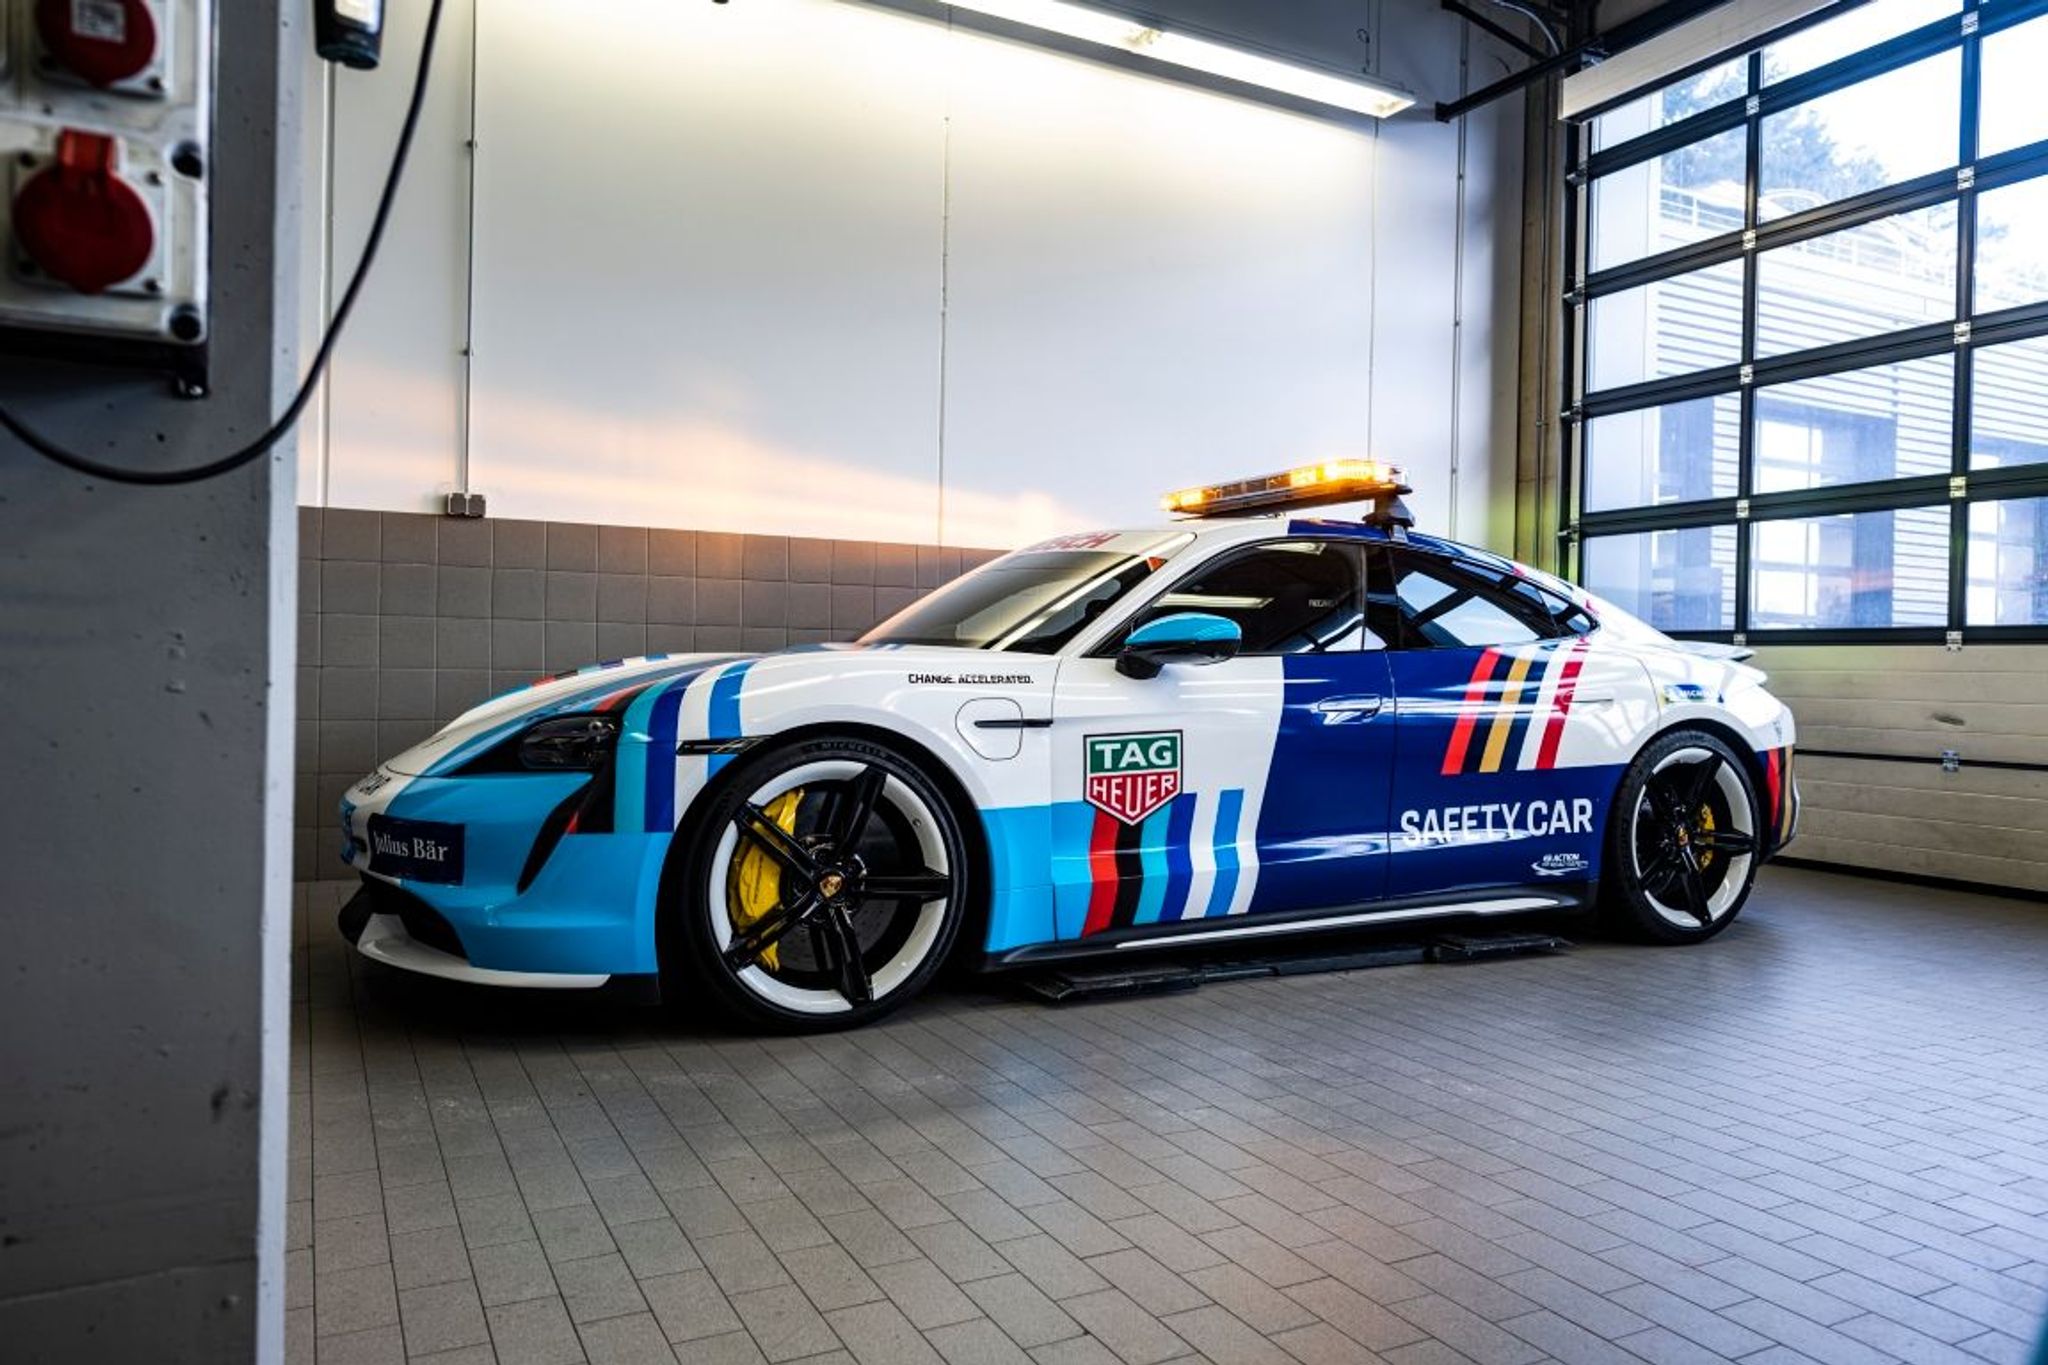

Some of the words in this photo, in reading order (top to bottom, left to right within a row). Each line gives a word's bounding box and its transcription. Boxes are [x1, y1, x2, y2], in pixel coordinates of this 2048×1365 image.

[957, 673, 1035, 685] ACCELERATED.
[1094, 740, 1172, 770] TAG
[1092, 774, 1175, 818] HEUER
[1400, 802, 1522, 847] SAFETY
[1526, 798, 1594, 837] CAR
[373, 830, 409, 857] Julius
[412, 837, 449, 861] Bär
